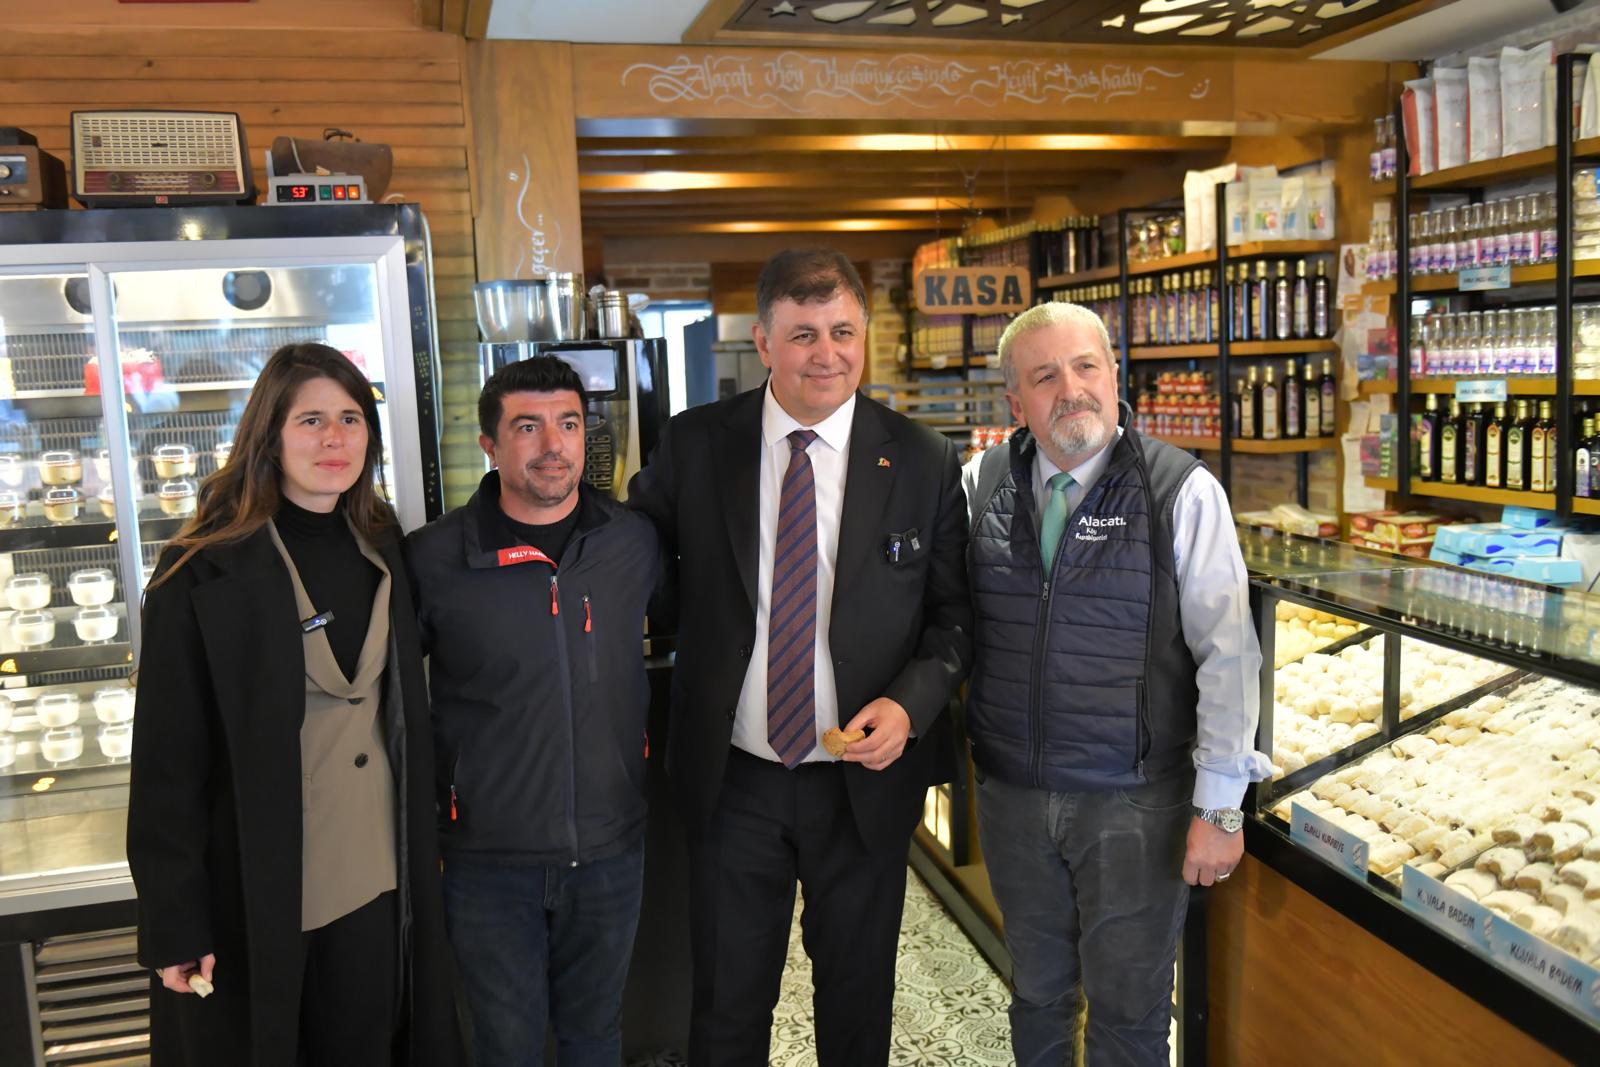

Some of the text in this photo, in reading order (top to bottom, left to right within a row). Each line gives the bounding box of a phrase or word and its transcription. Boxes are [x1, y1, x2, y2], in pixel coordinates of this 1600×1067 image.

[925, 275, 1022, 305] KASA
[508, 550, 528, 559] HELLY
[1447, 905, 1475, 930] BADEM
[1548, 964, 1583, 994] BADEM
